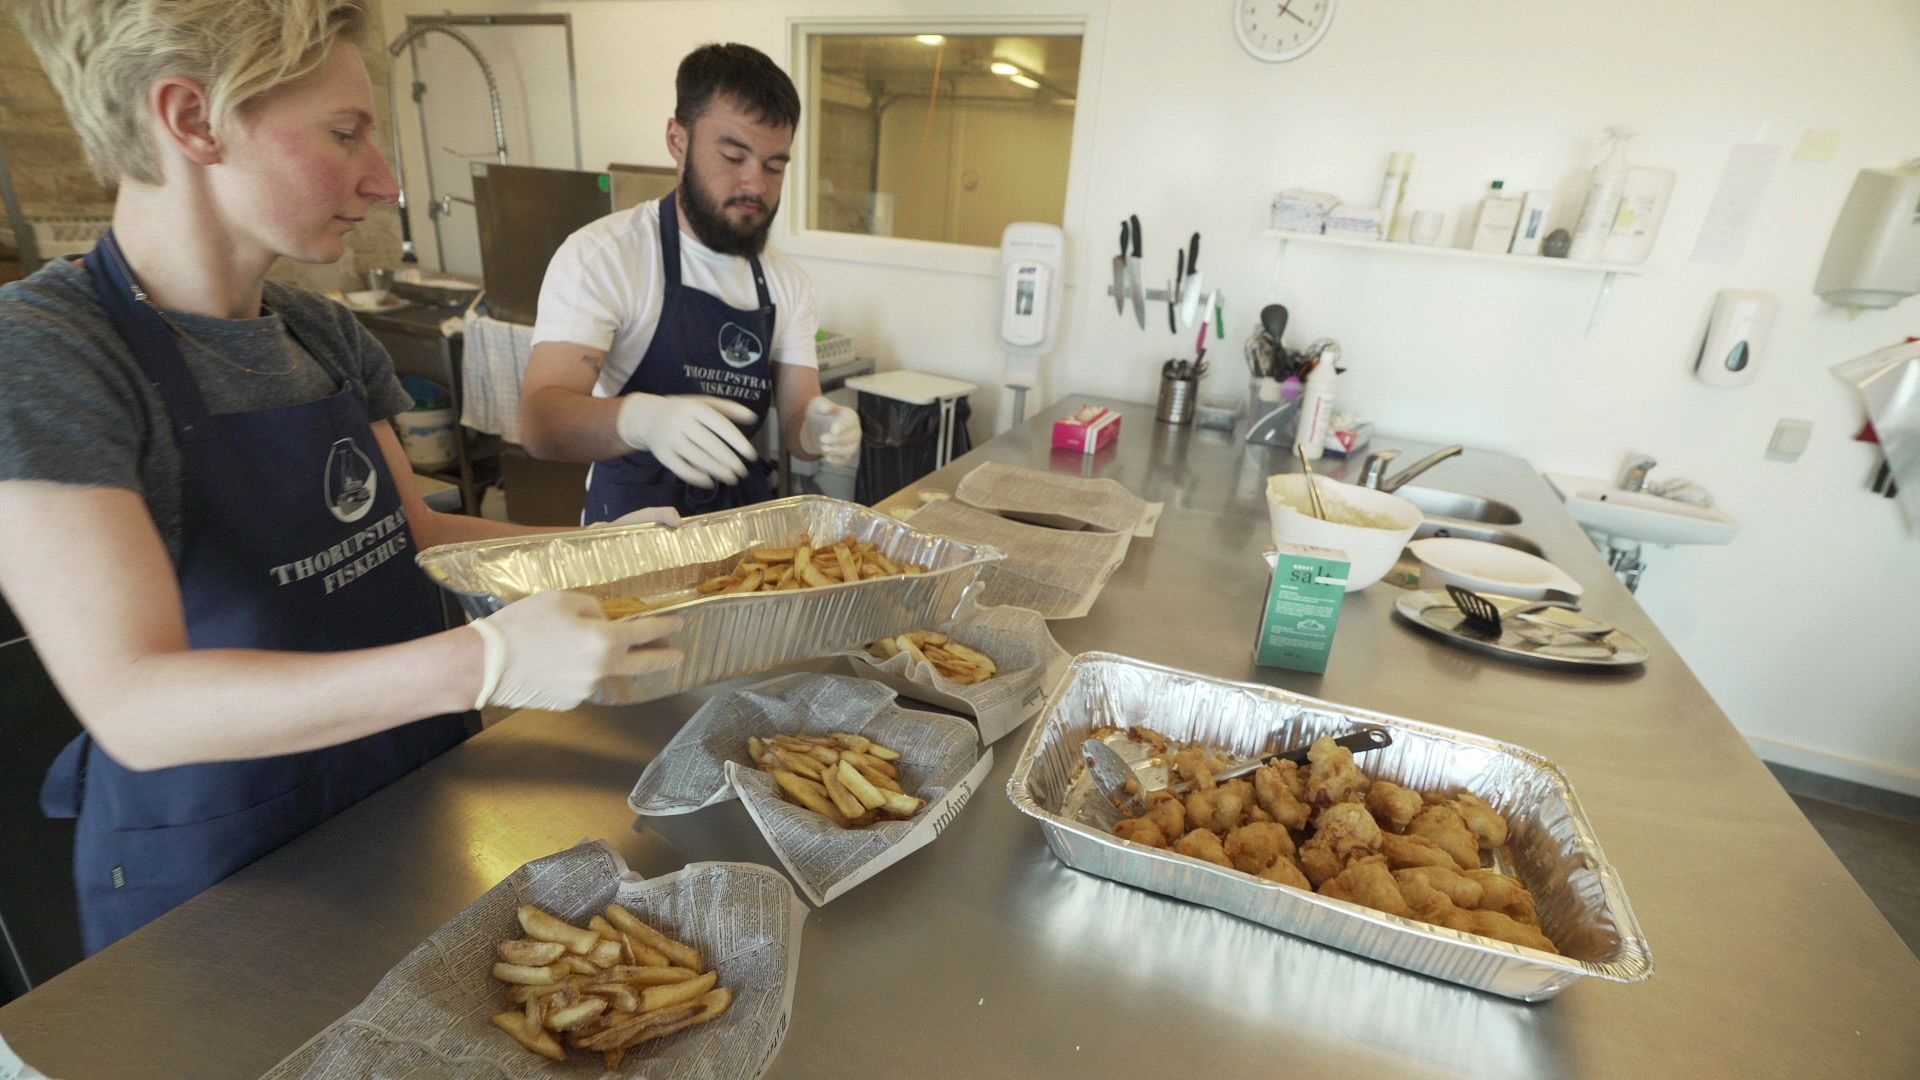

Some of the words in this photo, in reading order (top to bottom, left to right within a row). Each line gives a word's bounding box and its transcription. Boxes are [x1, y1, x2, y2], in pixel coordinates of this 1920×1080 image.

[683, 364, 772, 390] THORUPSTRA
[269, 508, 407, 586] THORUPSTRA
[323, 531, 407, 595] FISKEHUS
